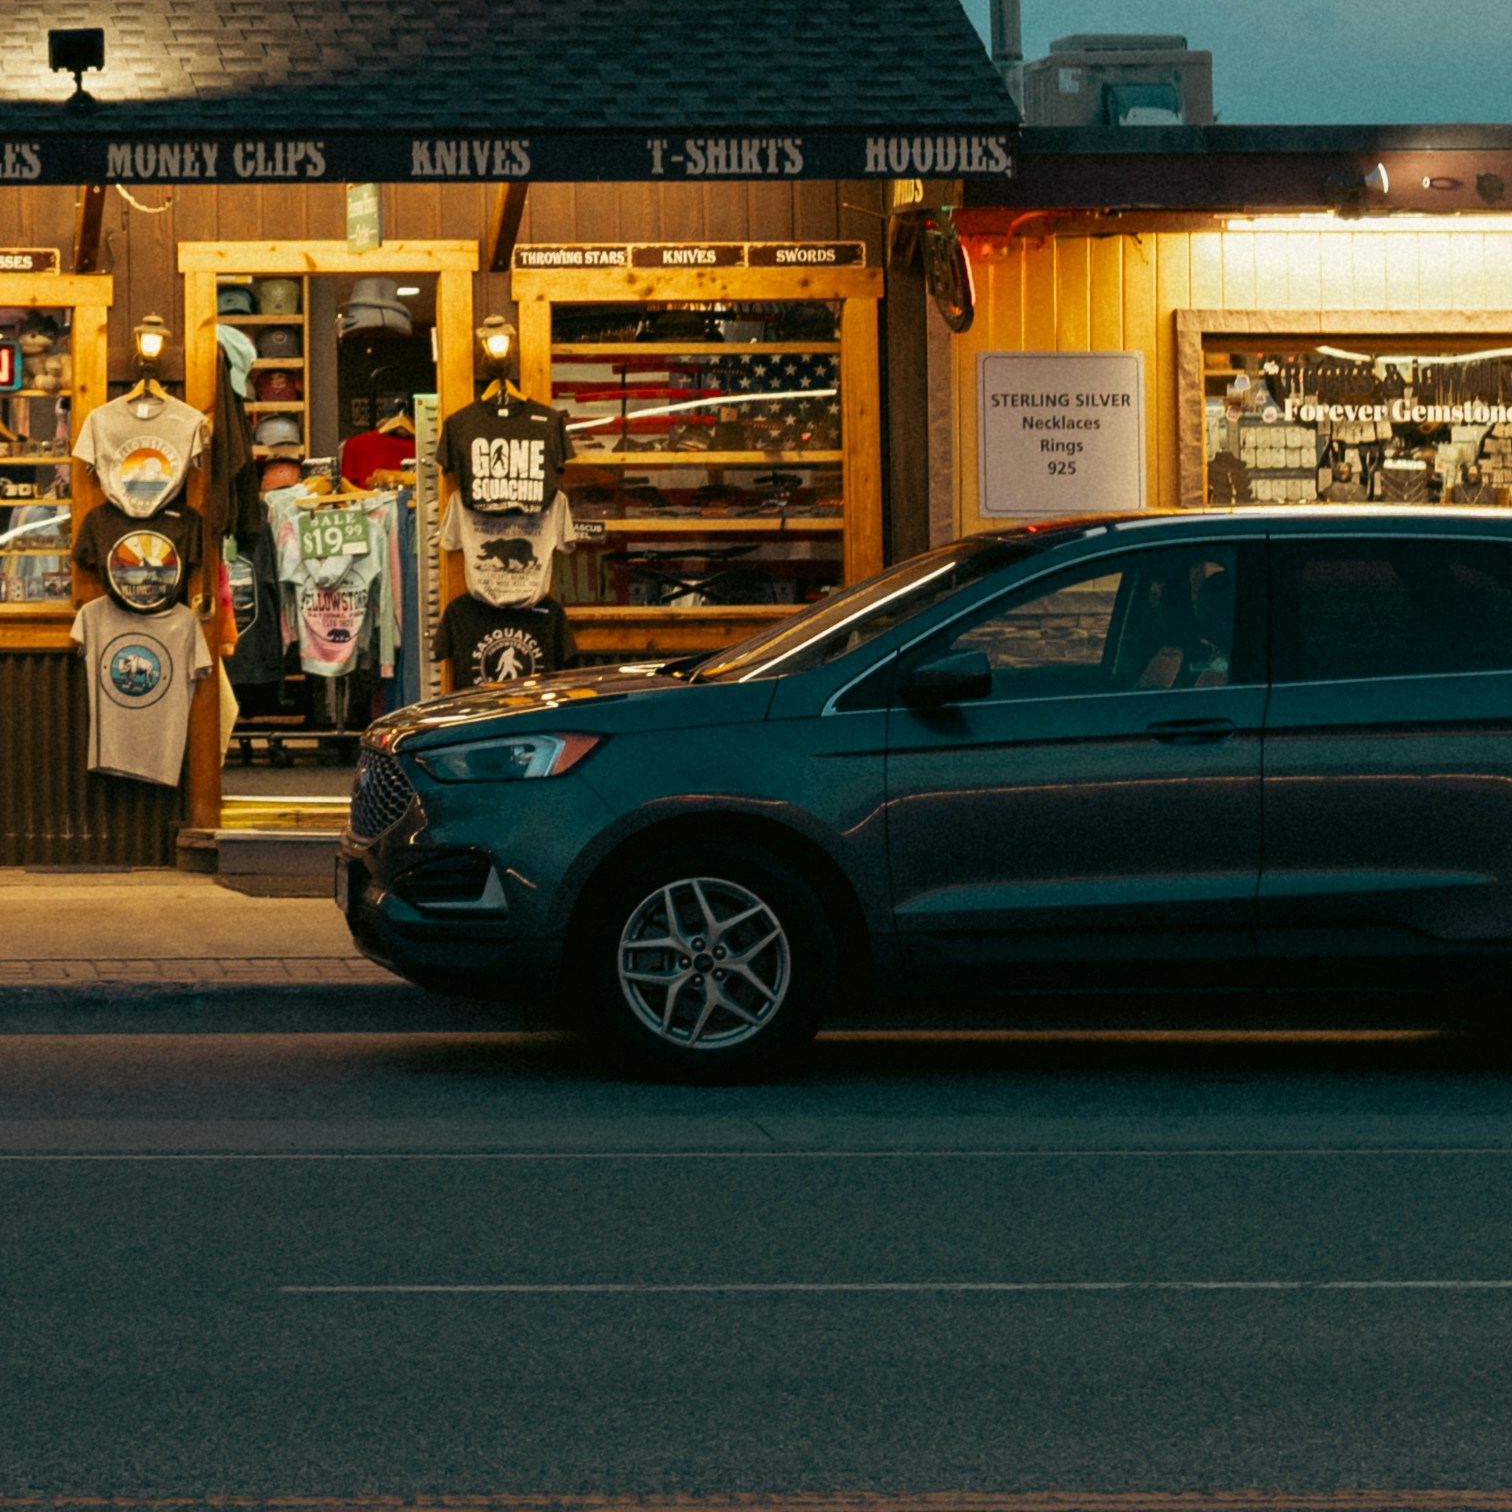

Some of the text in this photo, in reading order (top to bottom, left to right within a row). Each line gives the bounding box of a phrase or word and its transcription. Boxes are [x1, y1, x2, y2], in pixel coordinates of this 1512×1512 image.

[105, 140, 326, 181] MONEY CLIPS
[411, 139, 531, 178] KNIVES
[644, 138, 804, 176] T-SHIRTS
[863, 137, 1009, 177] HOODIES
[520, 248, 626, 266] THROWING STARS
[662, 248, 717, 264] KNIVES
[775, 247, 836, 263] SWORDS
[990, 393, 1131, 408] STERLING SILVER
[1284, 397, 1389, 422] Forever
[1022, 415, 1101, 430] Necklaces
[471, 436, 546, 481] GONE
[1040, 438, 1084, 456] Rings
[1047, 460, 1077, 475] 925
[471, 477, 545, 502] SQUACHIN
[310, 511, 357, 527] SALE
[302, 524, 363, 557] $19 99
[471, 626, 544, 661] SASQUATCH
